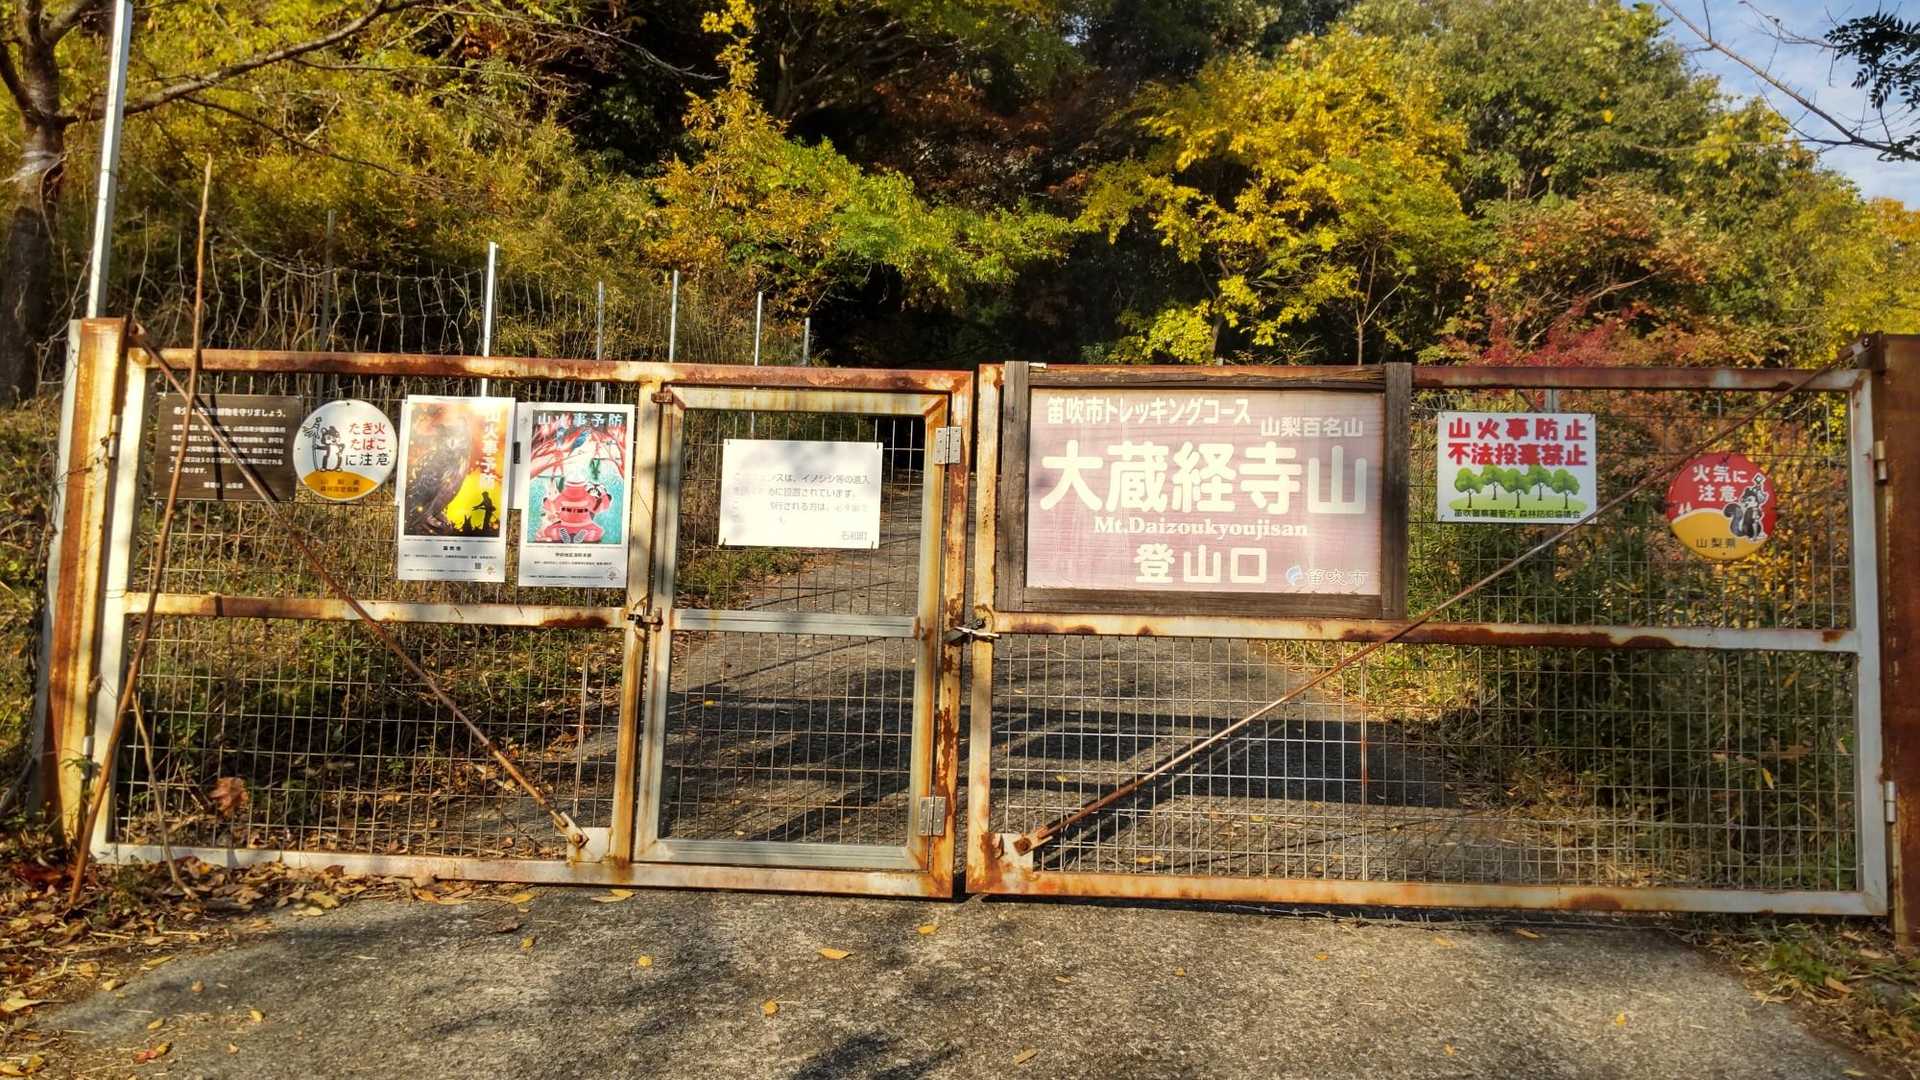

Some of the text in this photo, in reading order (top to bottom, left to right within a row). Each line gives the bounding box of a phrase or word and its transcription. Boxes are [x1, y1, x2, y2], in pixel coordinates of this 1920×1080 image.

[538, 412, 623, 427] 山火事予防
[1047, 397, 1251, 425] 笛吹市トレッキングコース
[349, 422, 386, 435] たき火
[1260, 416, 1364, 439] 山梨百名山
[1448, 417, 1587, 441] 山火事防止
[350, 437, 386, 451] たばこ
[345, 454, 390, 467] に注意
[1447, 442, 1587, 467] 不法投棄禁止
[1039, 438, 1368, 515] 大蔵経寺山
[1692, 464, 1748, 484] 火気に
[1697, 484, 1738, 503] 注意
[1695, 537, 1737, 549] 山梨県
[1135, 543, 1268, 585] 登山口
[1305, 567, 1369, 587] 笛吹市
